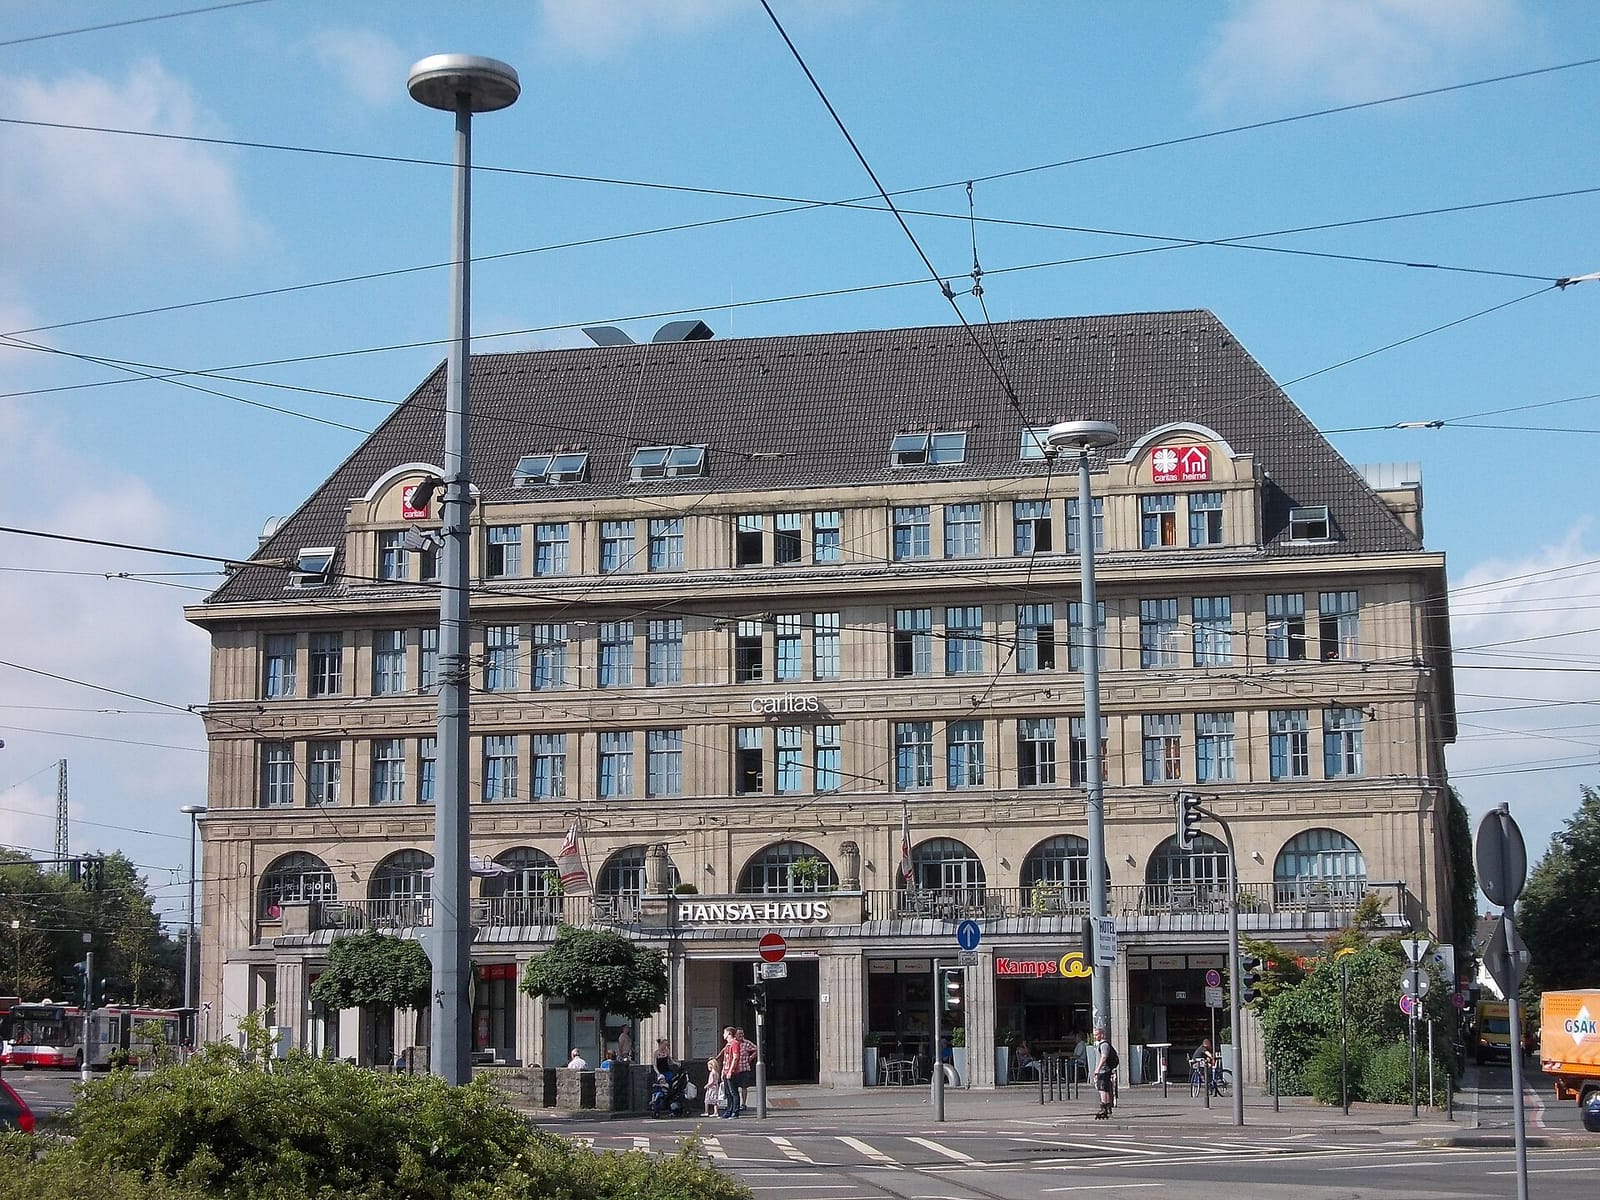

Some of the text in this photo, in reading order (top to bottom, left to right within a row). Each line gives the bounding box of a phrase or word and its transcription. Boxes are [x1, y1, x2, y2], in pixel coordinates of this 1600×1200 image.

[1183, 472, 1206, 480] heime
[751, 691, 819, 713] caritas
[678, 902, 828, 921] HANSA-HAUS
[1100, 920, 1116, 934] HOTEL
[996, 957, 1057, 977] Kamps
[1564, 1019, 1597, 1034] GSAK
